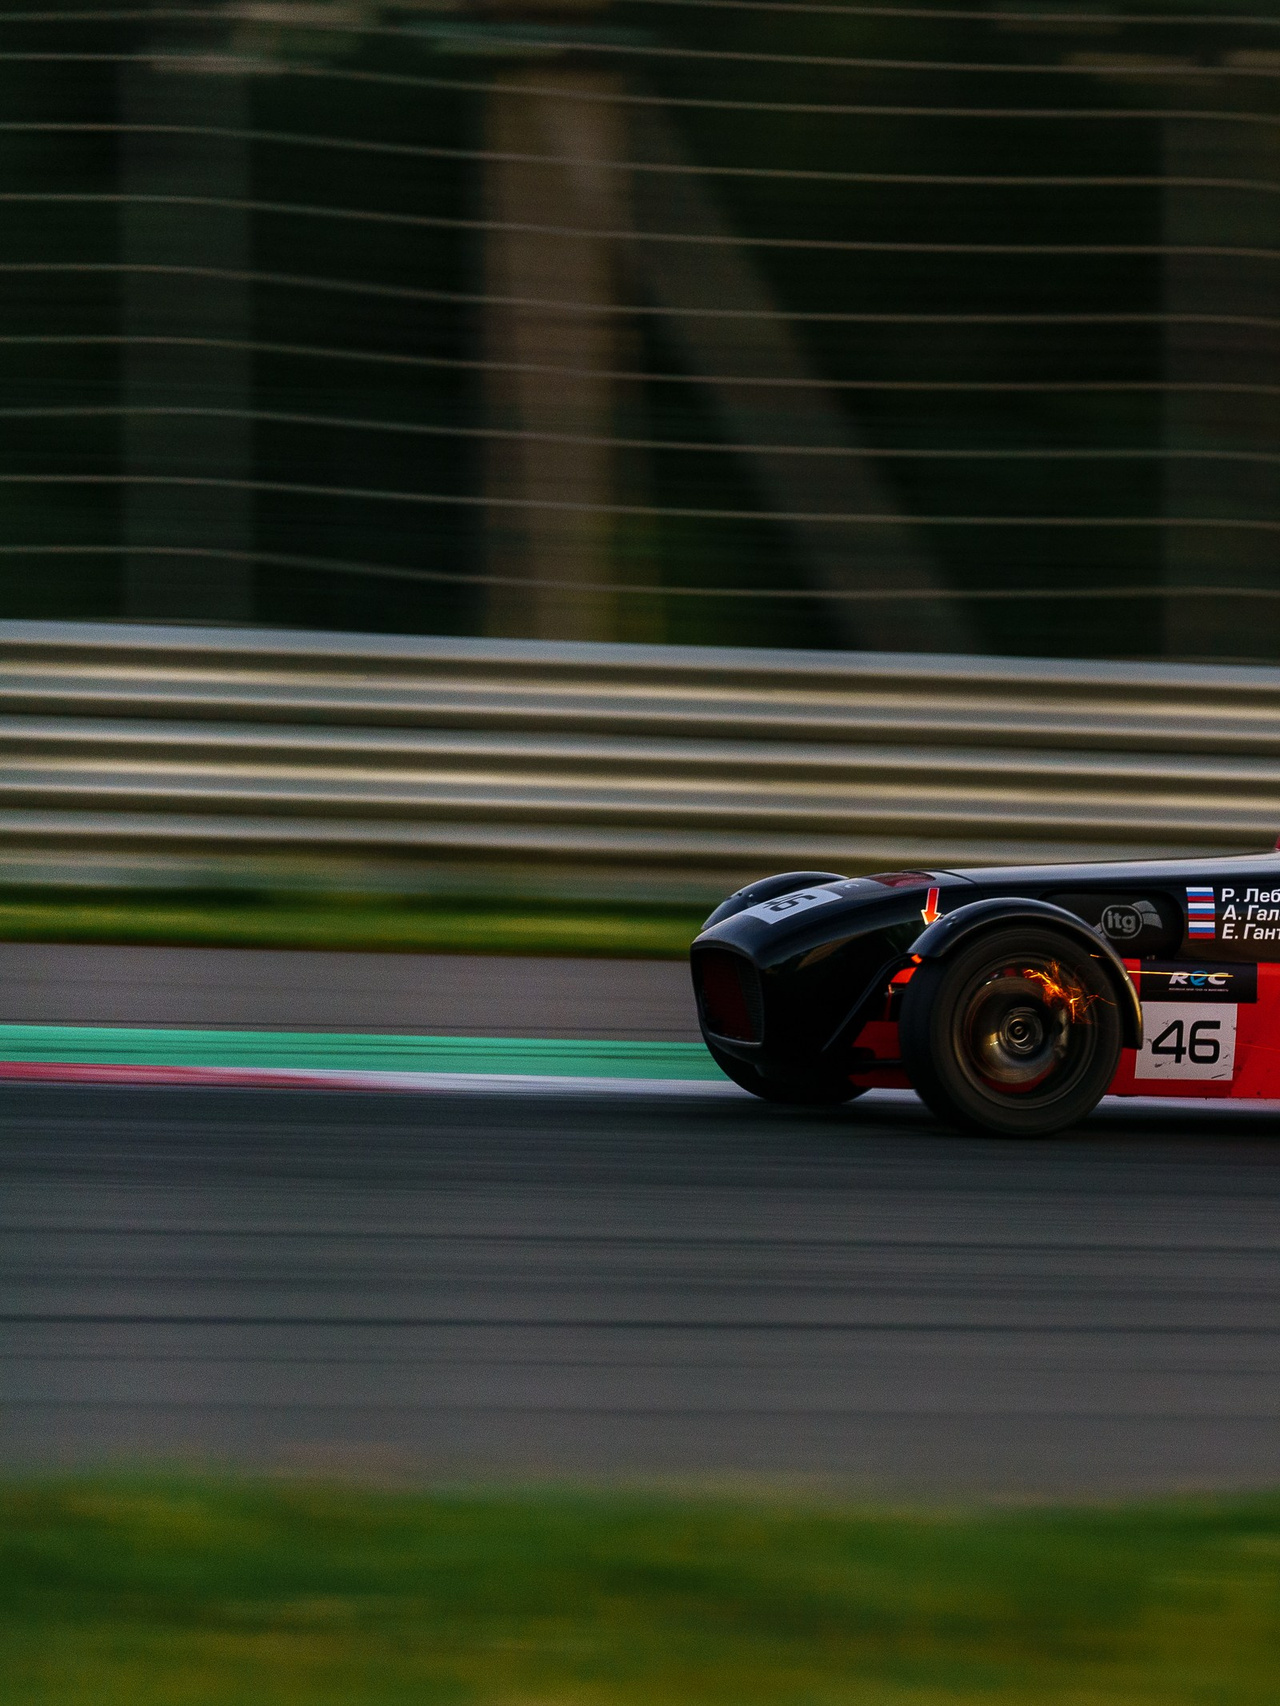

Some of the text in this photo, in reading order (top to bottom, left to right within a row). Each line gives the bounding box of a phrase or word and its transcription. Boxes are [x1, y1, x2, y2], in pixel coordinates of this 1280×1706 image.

[1221, 888, 1240, 902] Р.
[1222, 904, 1242, 921] А.
[1107, 910, 1136, 933] itg
[1222, 923, 1239, 939] Е.
[1151, 1019, 1221, 1064] 46
